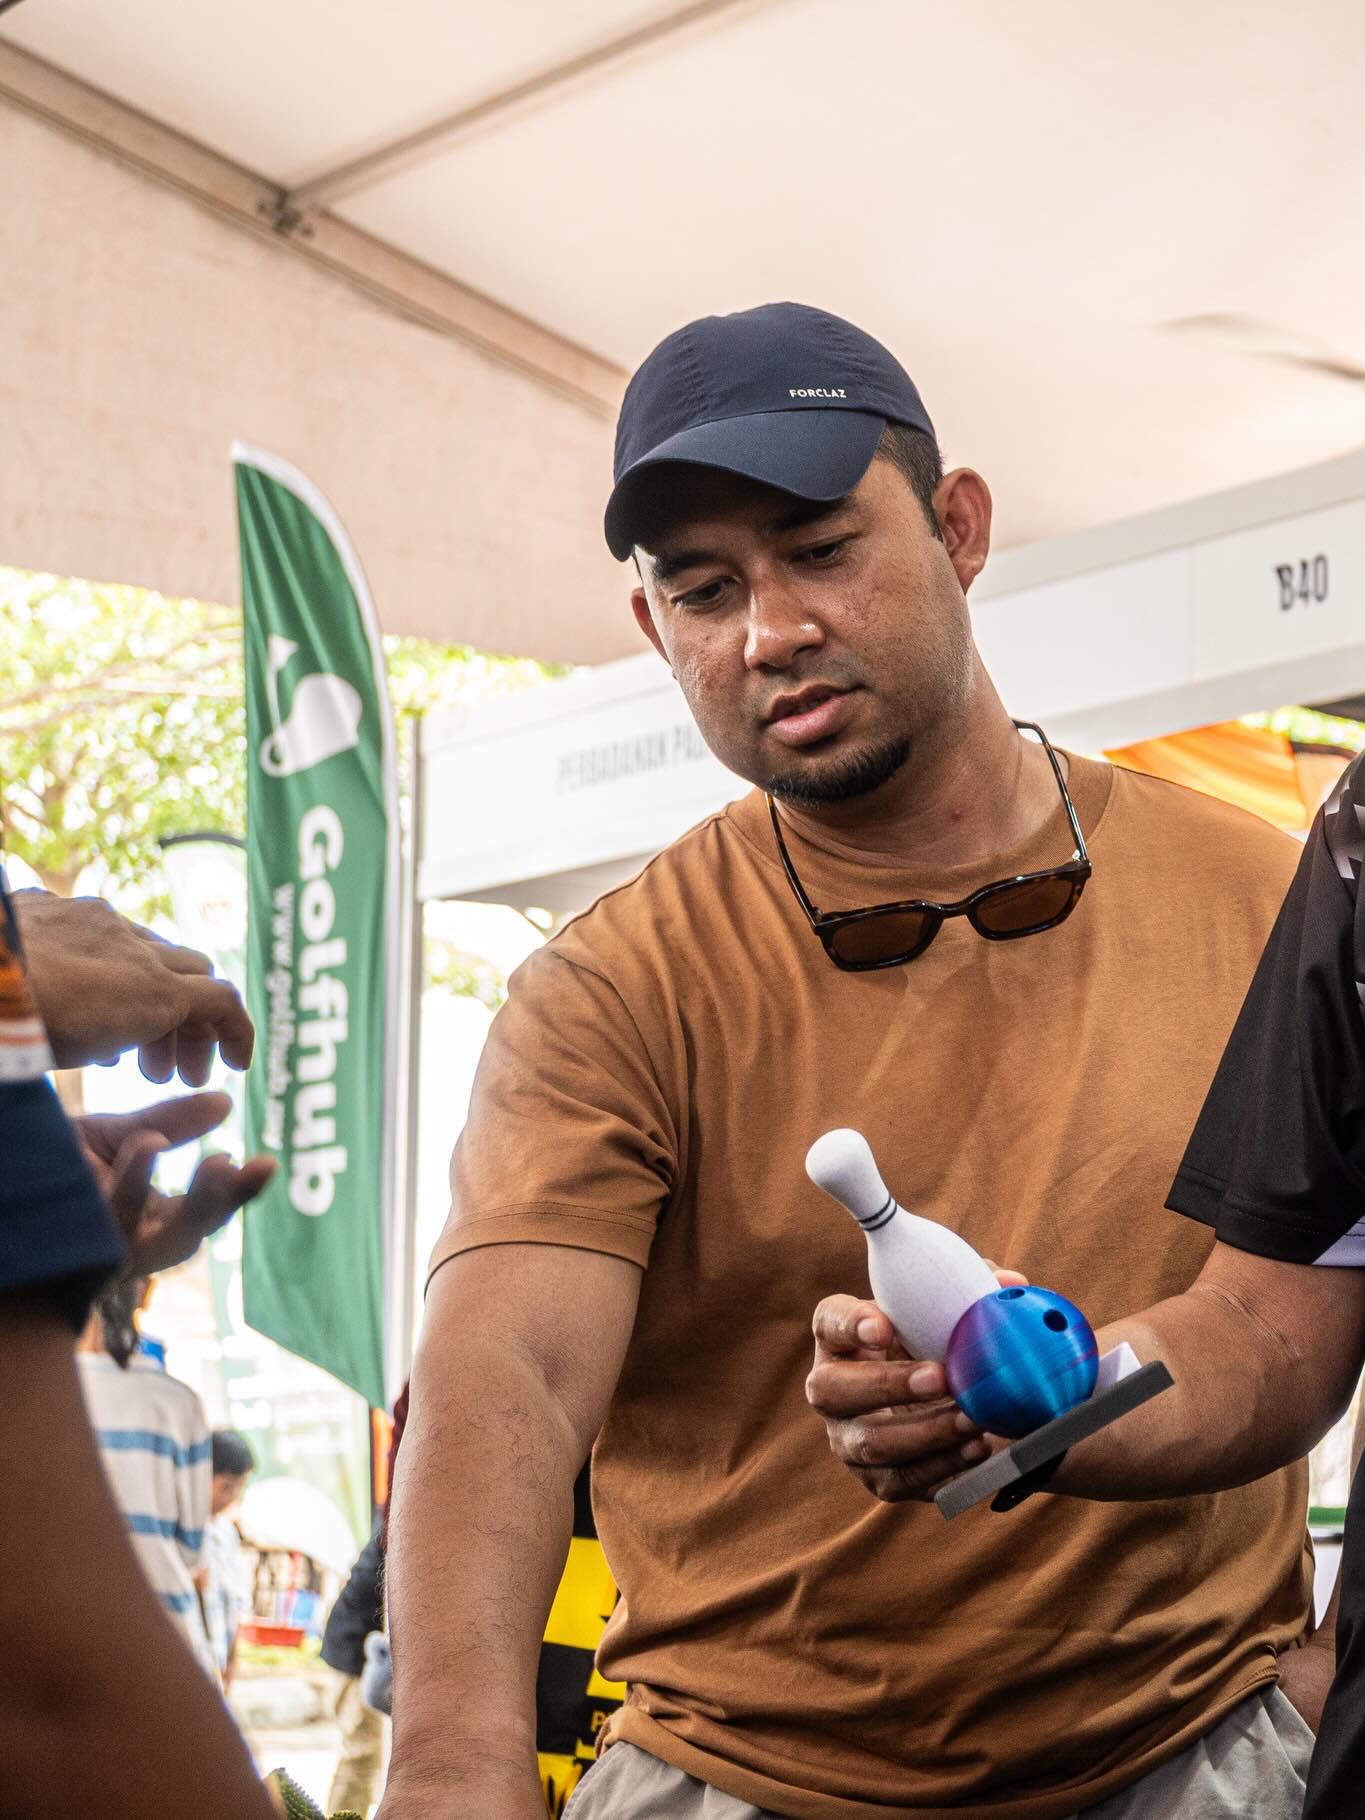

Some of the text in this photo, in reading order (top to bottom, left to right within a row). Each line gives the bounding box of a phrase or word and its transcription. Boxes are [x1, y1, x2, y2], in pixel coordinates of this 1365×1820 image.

[789, 388, 847, 399] FORCLAZ
[1276, 554, 1328, 611] B40
[288, 804, 347, 1217] Golfhub
